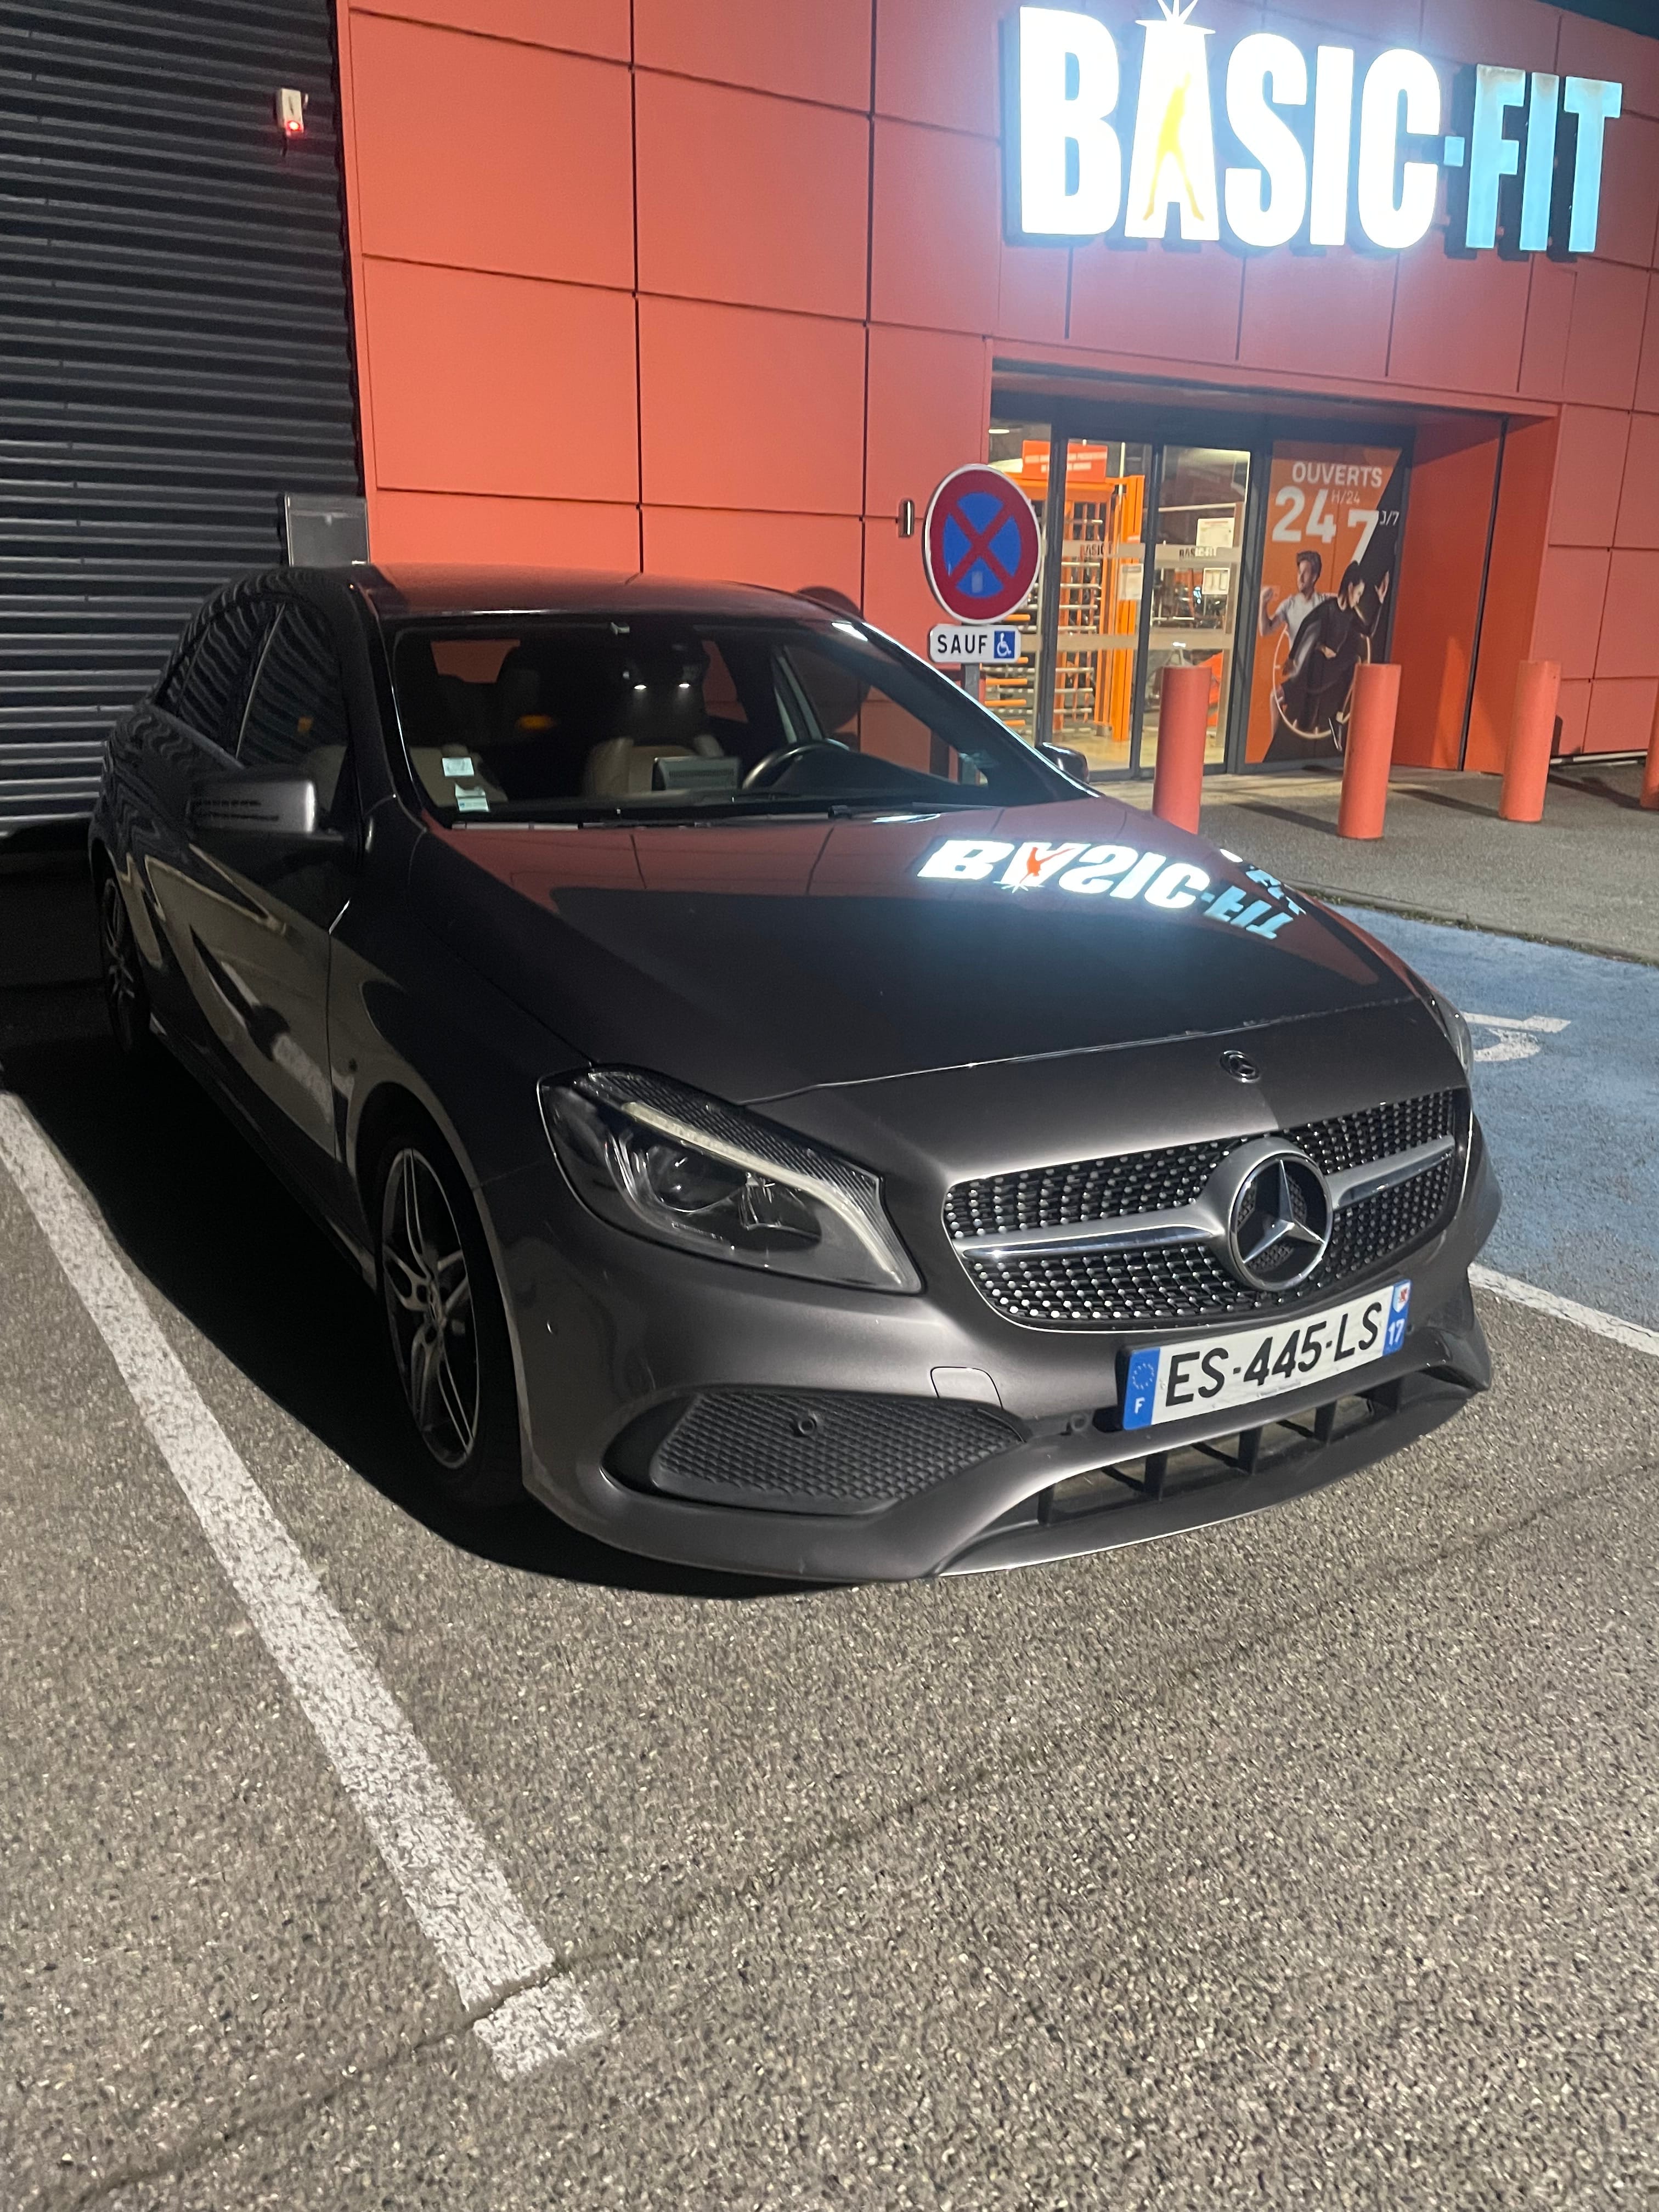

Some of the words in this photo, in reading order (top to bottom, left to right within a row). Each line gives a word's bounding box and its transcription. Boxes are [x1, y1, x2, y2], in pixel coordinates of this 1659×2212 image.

[1019, 1, 1622, 252] BASIC-FIT
[1292, 461, 1383, 488] OUVERTS
[1272, 486, 1336, 544] 24
[1347, 509, 1379, 566] 7
[937, 634, 988, 654] SAUF
[1135, 1397, 1146, 1414] F
[1165, 1301, 1382, 1407] ES-445-LS
[1388, 1318, 1405, 1346] 17
